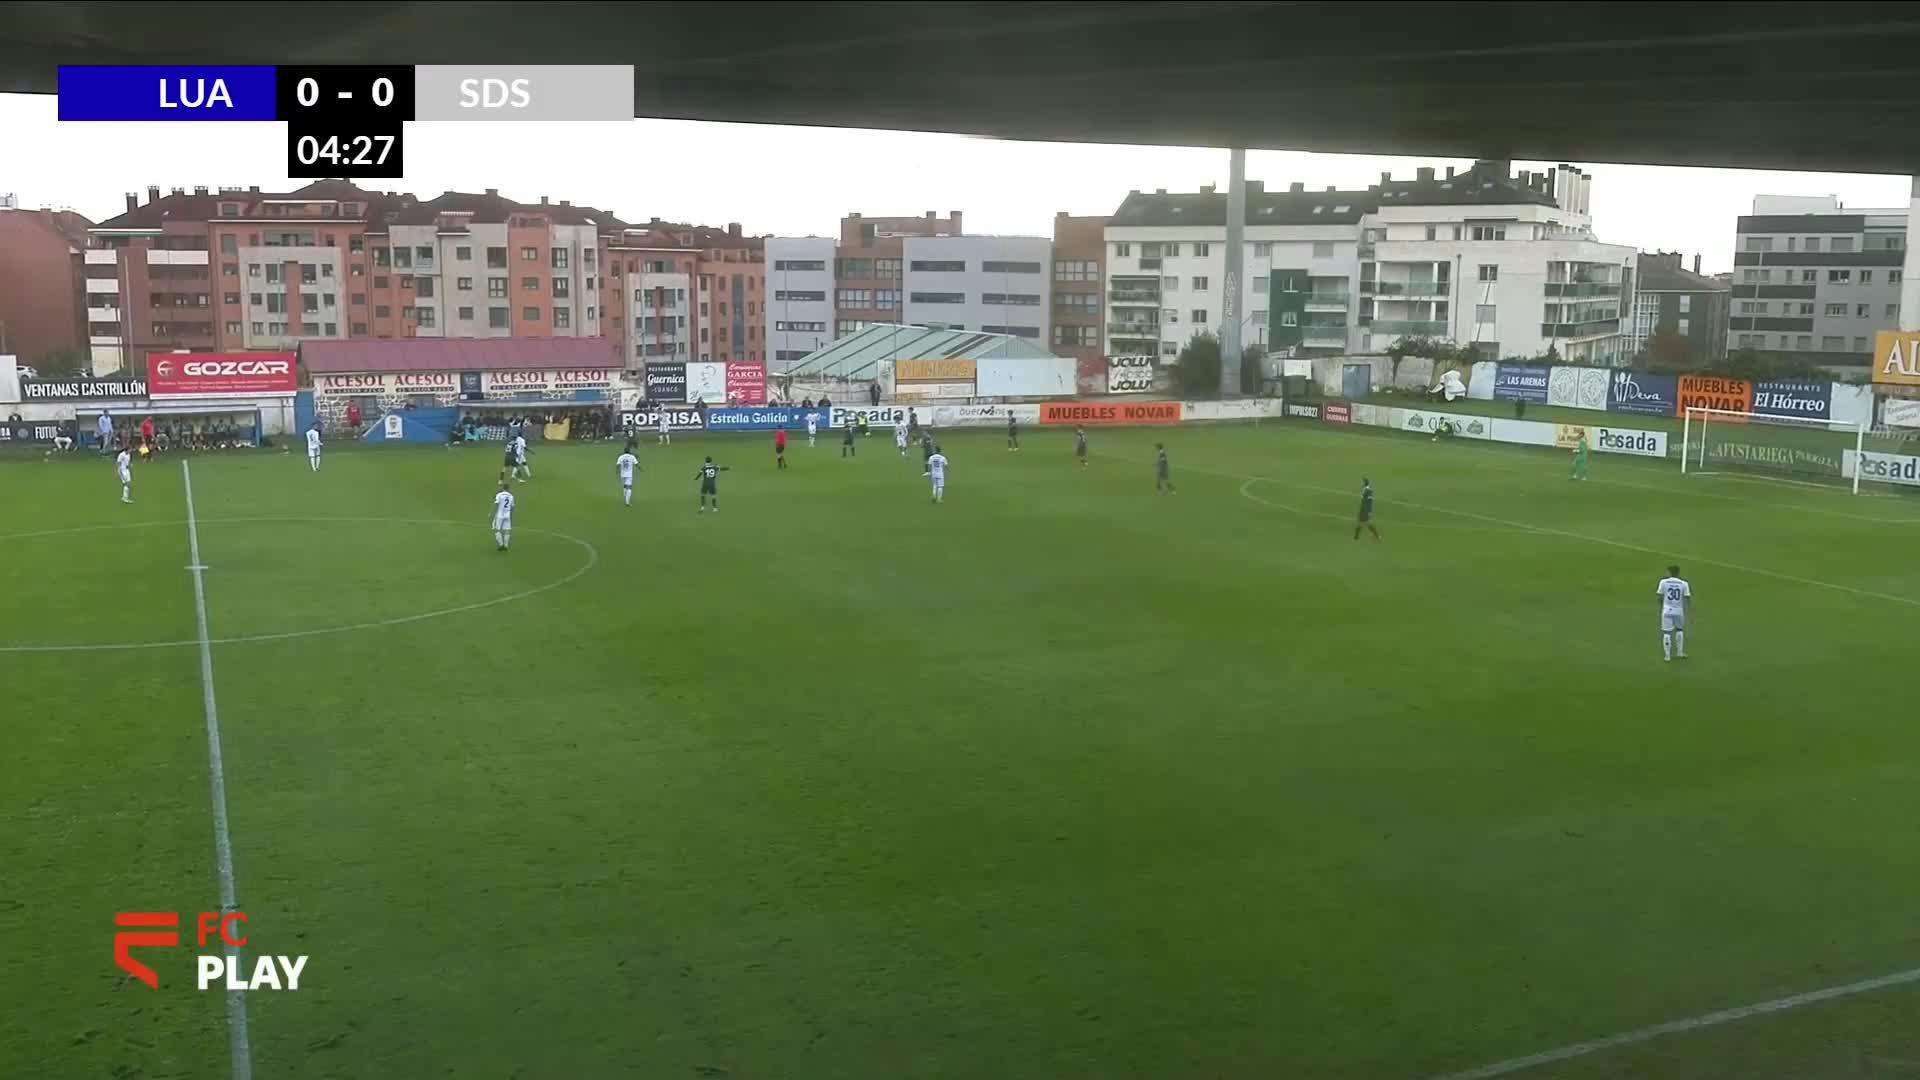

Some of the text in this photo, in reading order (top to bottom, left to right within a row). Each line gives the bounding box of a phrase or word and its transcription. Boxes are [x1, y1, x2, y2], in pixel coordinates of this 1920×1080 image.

[183, 361, 289, 376] GOZCAR
[323, 374, 386, 387] ACESOL
[394, 373, 456, 386] ACESOL
[490, 371, 549, 384] ACESOL
[647, 373, 686, 386] Guernica
[1506, 376, 1547, 388] LAS ARENAS
[24, 383, 80, 397] VENTANAS
[81, 380, 147, 396] CASTRILLÓN
[1682, 378, 1744, 395] MUEBLES
[1754, 392, 1825, 412] El Hórreo
[710, 411, 788, 424] Estrella Galicia
[1048, 406, 1174, 419] MUEBLES NOVAR
[1599, 428, 1657, 451] Posada
[704, 468, 715, 478] 19
[503, 498, 510, 508] 2
[1667, 587, 1681, 601] 30
